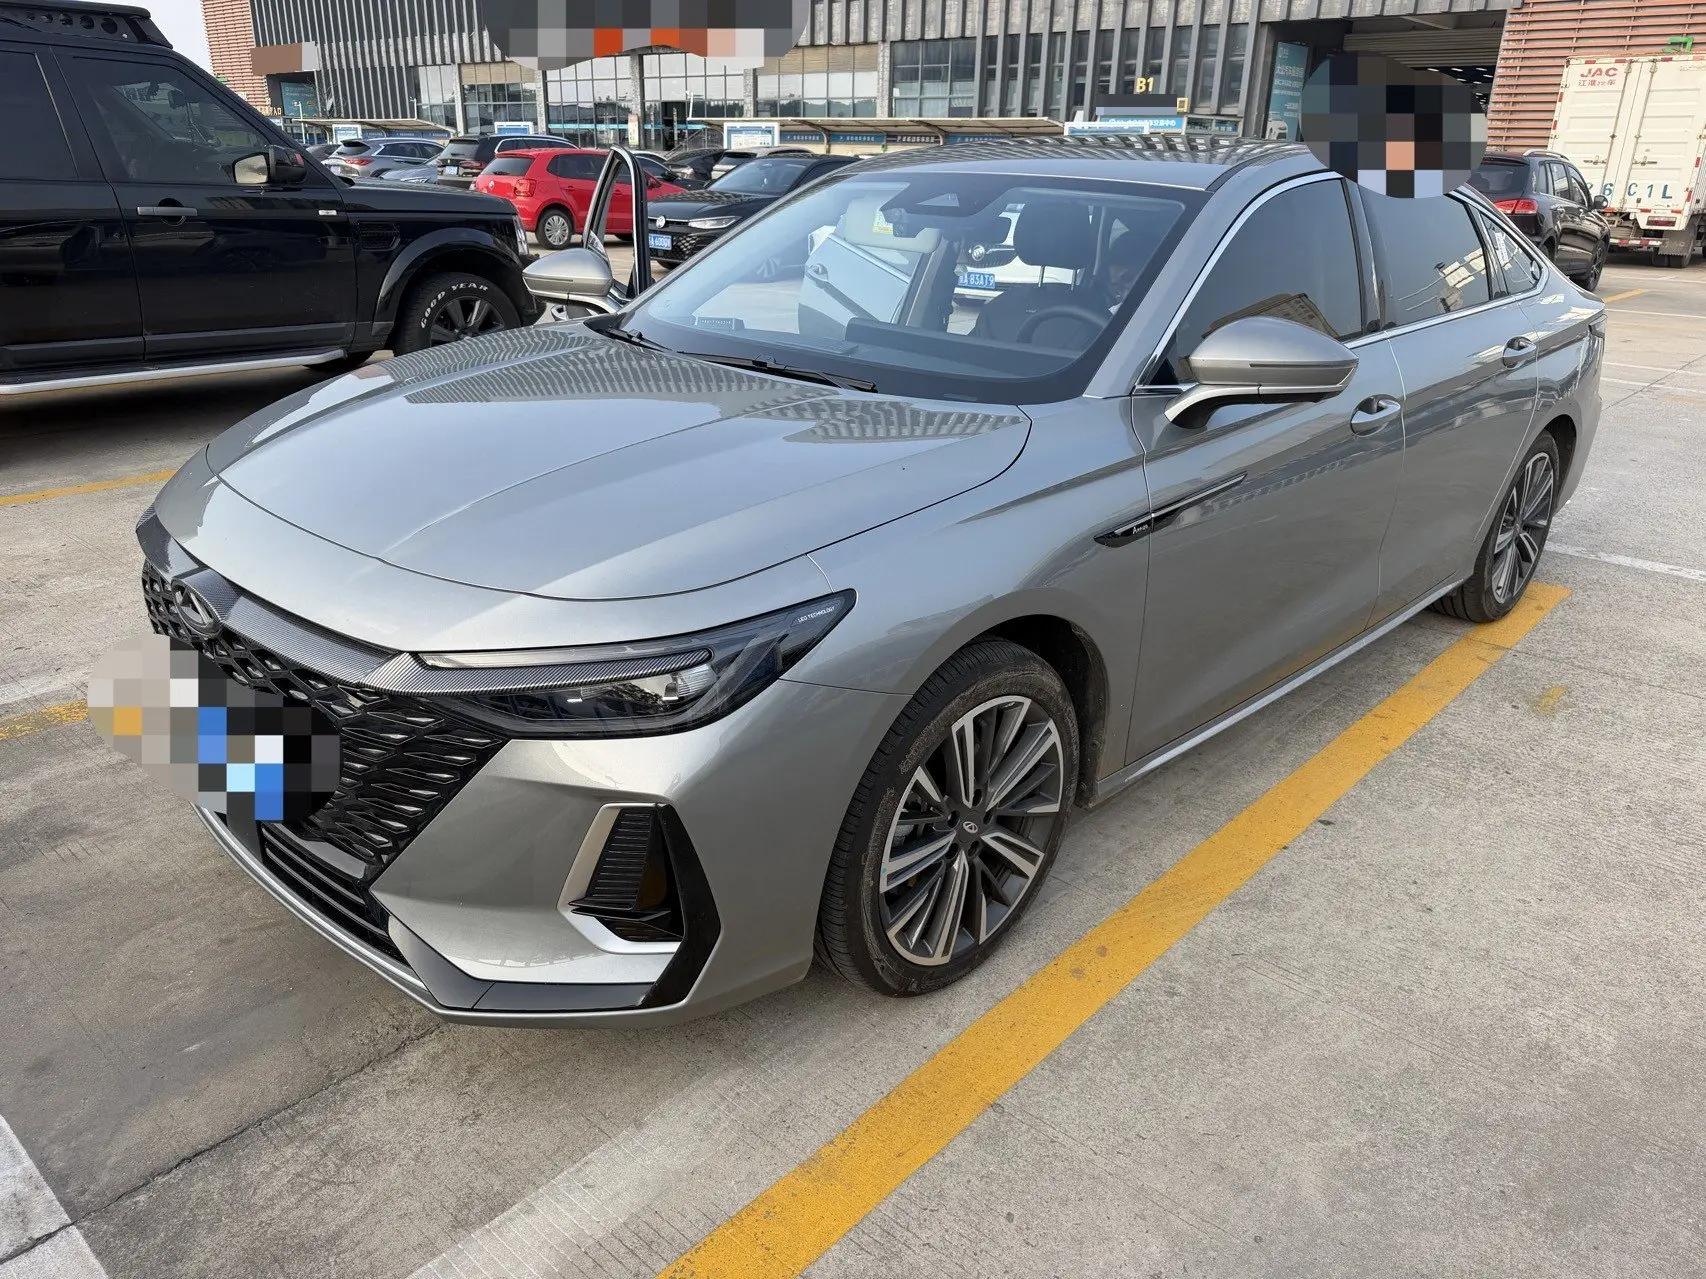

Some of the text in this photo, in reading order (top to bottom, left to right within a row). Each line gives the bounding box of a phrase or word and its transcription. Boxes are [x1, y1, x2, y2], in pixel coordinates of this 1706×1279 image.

[1580, 67, 1618, 78] JAC
[1136, 77, 1154, 92] B1
[421, 282, 488, 328] GOOD YEAR
